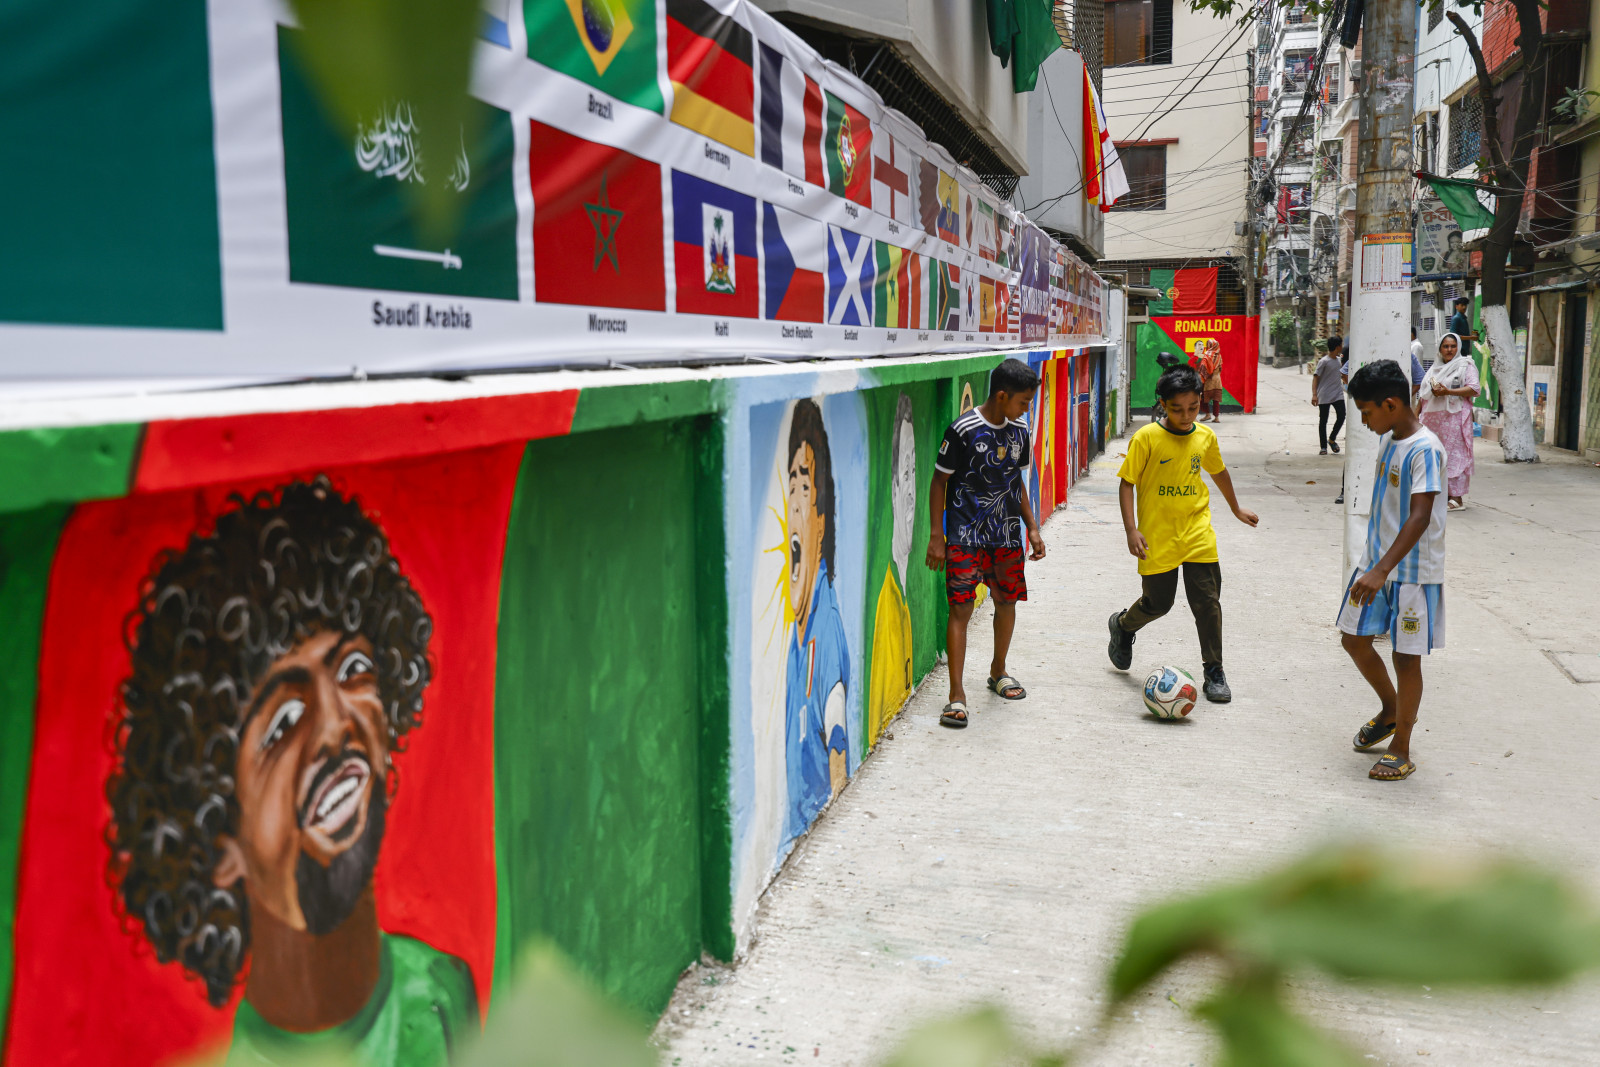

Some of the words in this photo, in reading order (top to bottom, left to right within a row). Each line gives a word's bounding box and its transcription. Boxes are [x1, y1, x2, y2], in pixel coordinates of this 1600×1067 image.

[588, 93, 614, 121] Brazil
[705, 142, 731, 170] Germany
[788, 179, 805, 197] France
[372, 300, 420, 326] Saudi
[425, 303, 472, 329] Arabia
[588, 313, 628, 333] Morocco
[781, 325, 795, 339] Czech
[1175, 318, 1232, 333] RONALDO
[1158, 485, 1197, 497] BRAZIL
